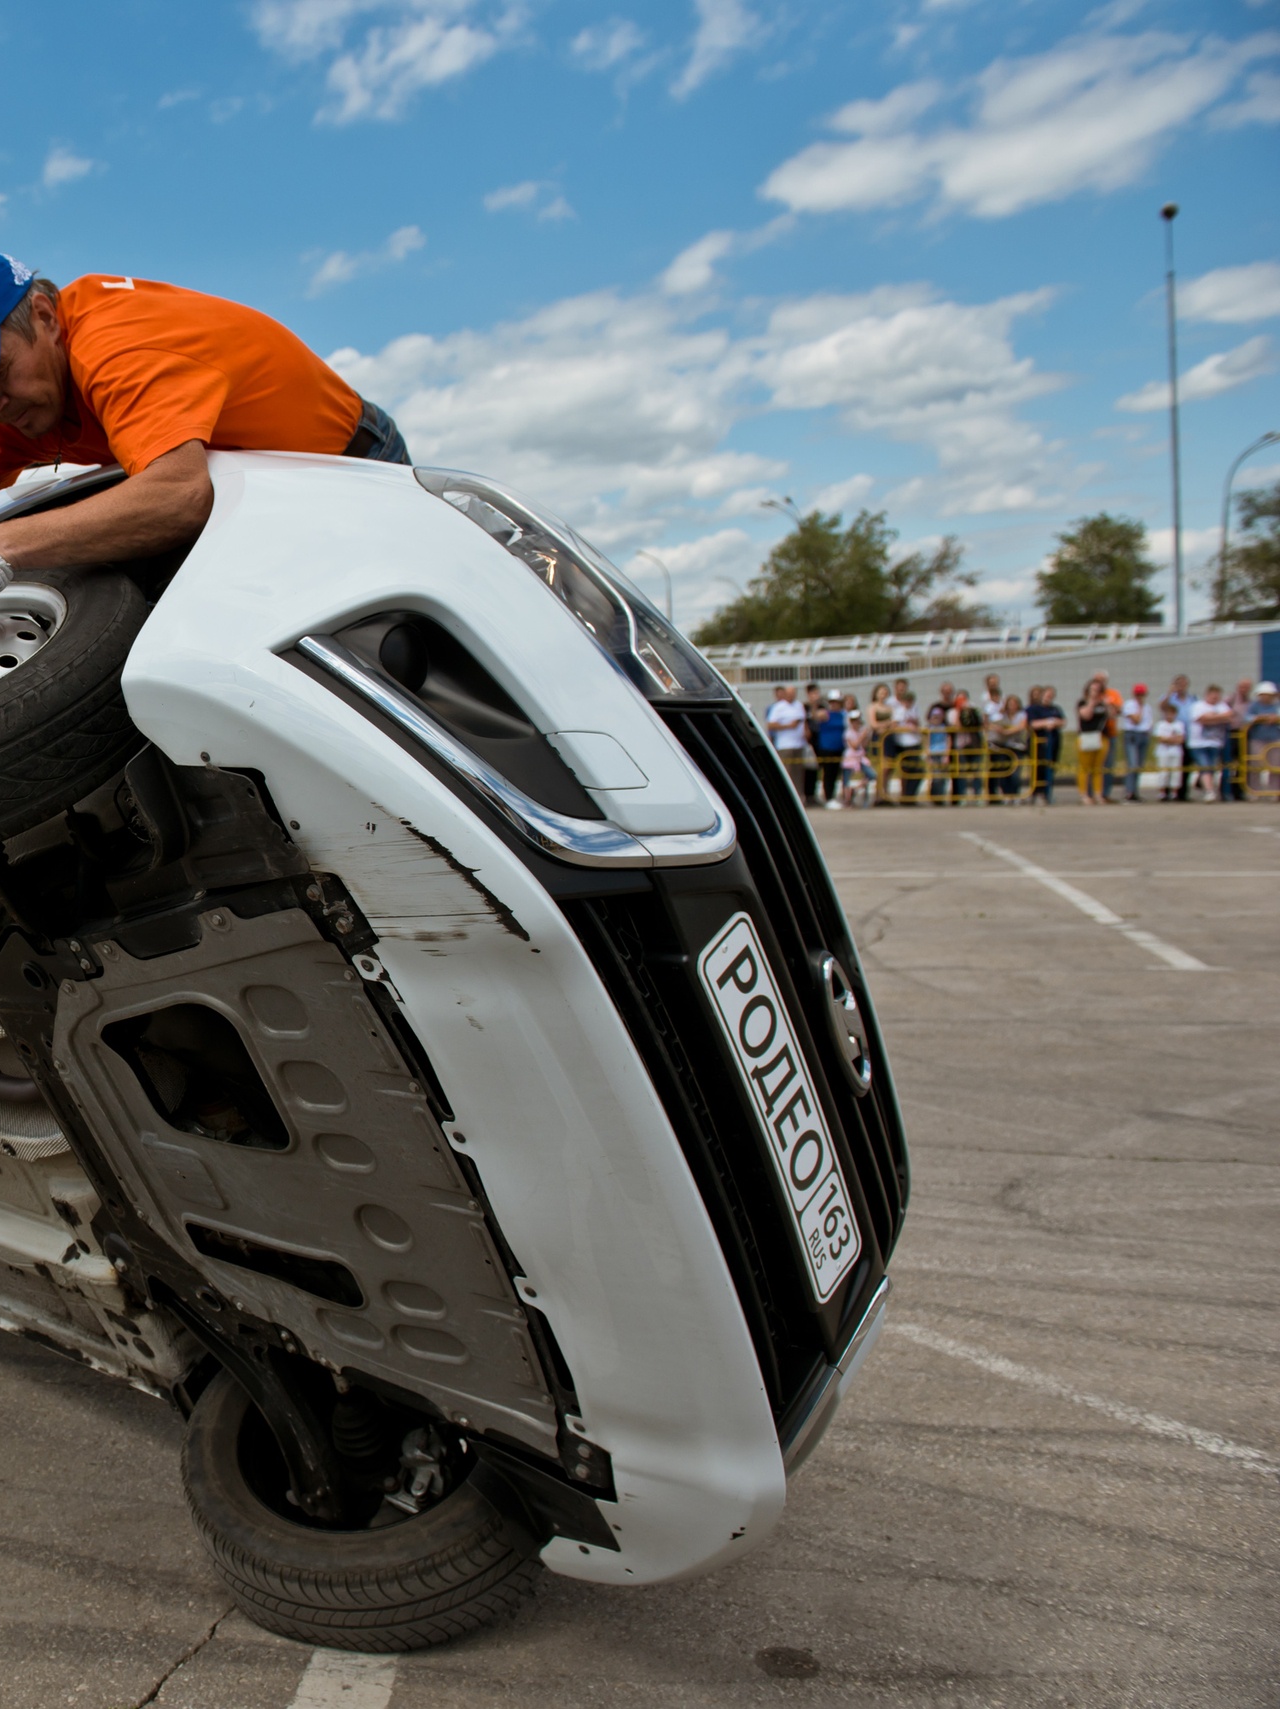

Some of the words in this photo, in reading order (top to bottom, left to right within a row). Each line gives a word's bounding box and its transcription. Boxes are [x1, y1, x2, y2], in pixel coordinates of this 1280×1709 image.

[716, 944, 824, 1192] РОДЕО
[817, 1182, 851, 1261] 163
[808, 1227, 828, 1271] RUS
